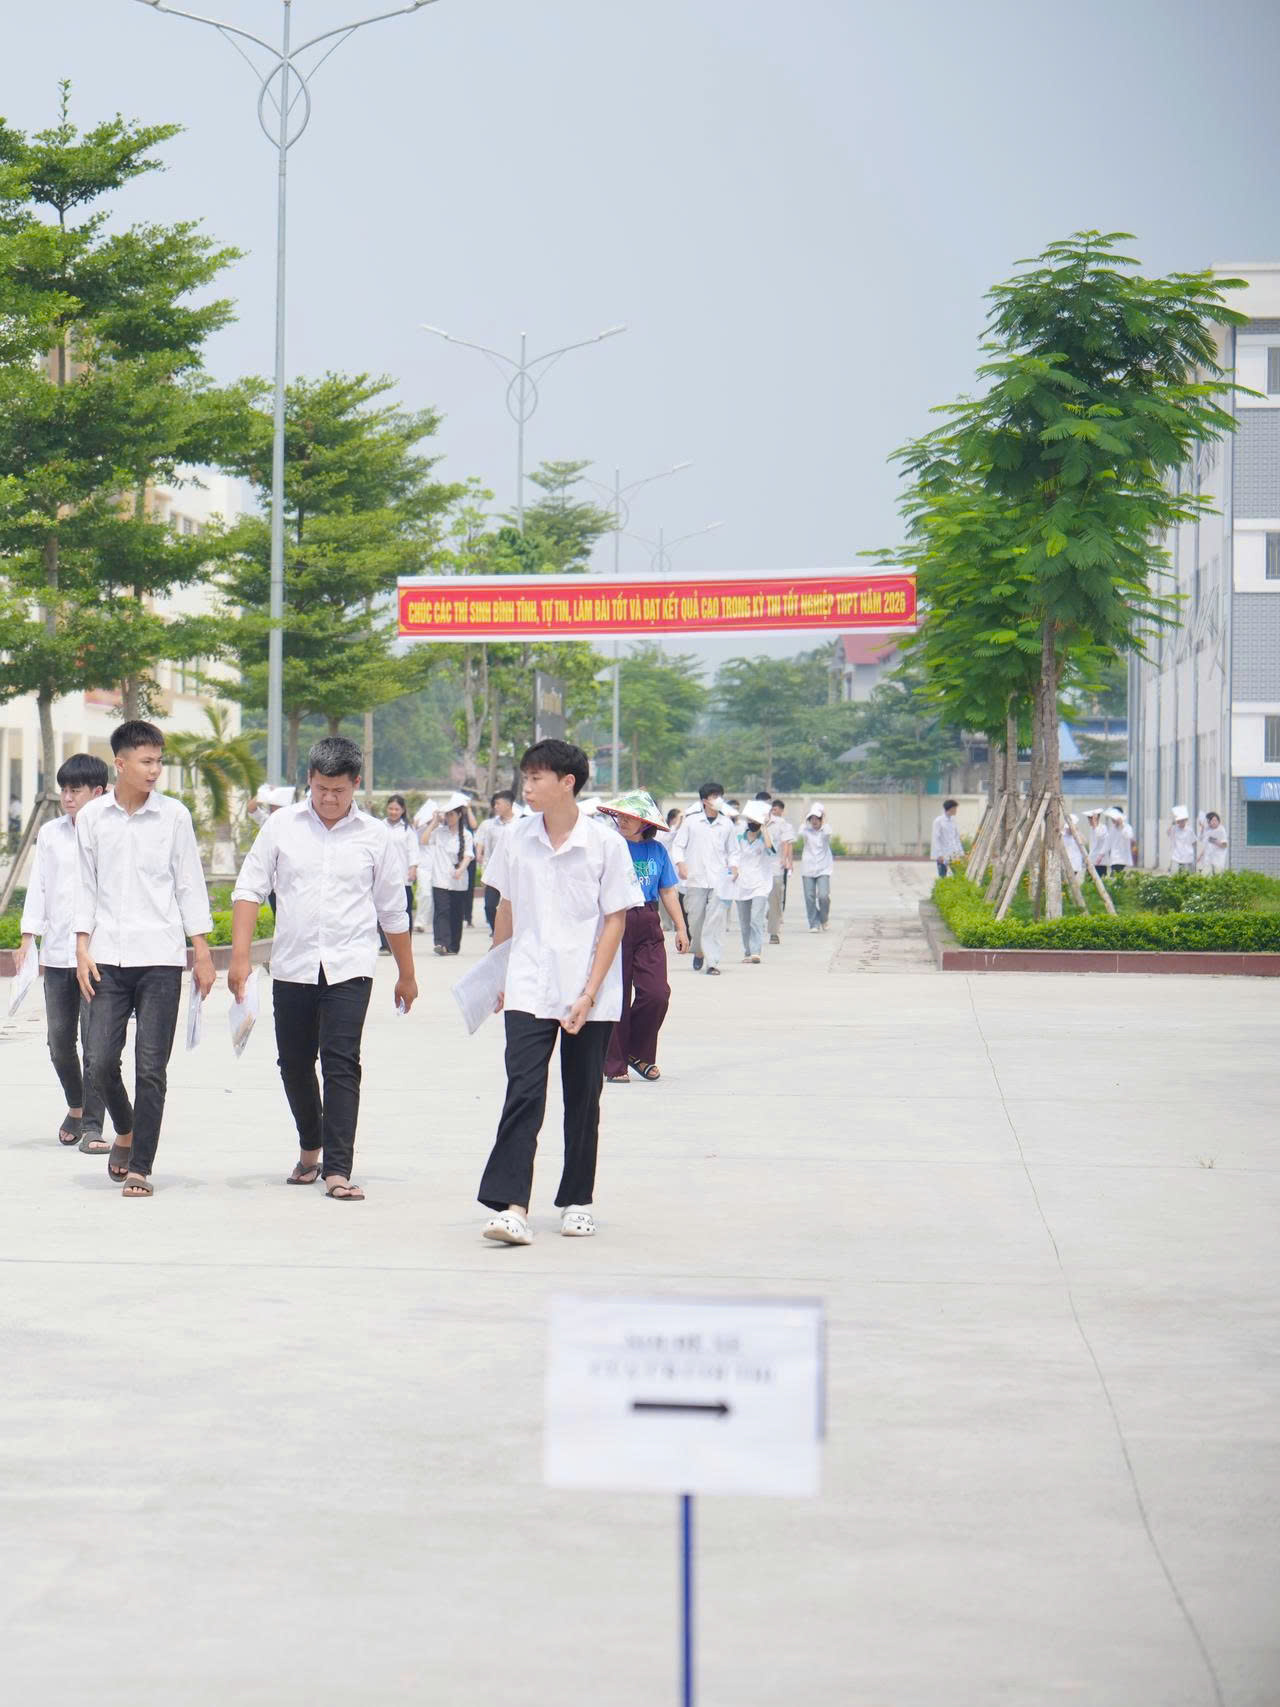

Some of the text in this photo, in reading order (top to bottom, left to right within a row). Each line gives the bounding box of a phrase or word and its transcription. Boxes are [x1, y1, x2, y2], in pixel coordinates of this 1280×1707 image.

[434, 597, 452, 624] CÁC
[454, 597, 468, 623] THÍ
[469, 600, 491, 623] SINH
[573, 595, 593, 621] LÀM
[594, 594, 610, 621] BÀI
[612, 592, 627, 621] TỐT
[629, 594, 641, 620] VÀ
[643, 597, 660, 624] ĐẠT
[662, 592, 679, 620] KẾT
[681, 590, 699, 621] QUẢ
[701, 597, 719, 618] CAO
[721, 595, 751, 618] TRONG
[766, 595, 781, 617] THI
[782, 587, 798, 616] TỐT
[836, 592, 858, 615] THPT
[860, 587, 881, 614] NĂM
